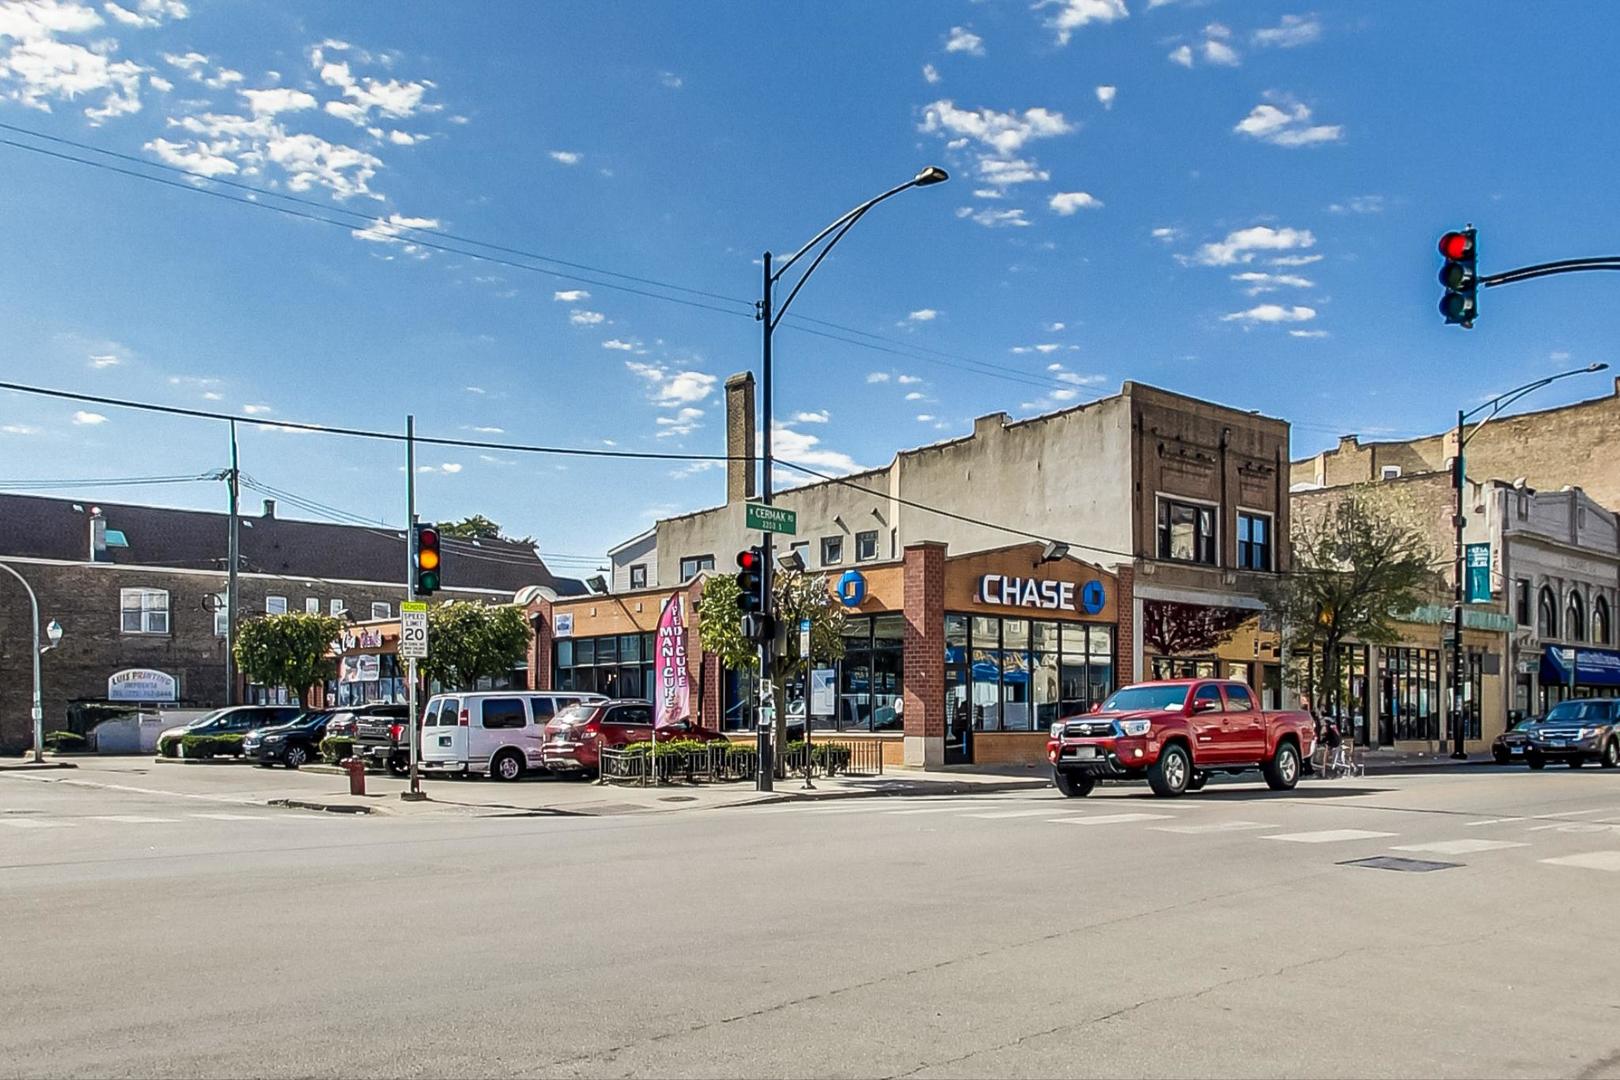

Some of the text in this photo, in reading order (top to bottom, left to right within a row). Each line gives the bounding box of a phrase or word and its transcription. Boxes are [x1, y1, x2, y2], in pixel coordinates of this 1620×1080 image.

[755, 508, 785, 522] CERMAK
[981, 574, 1076, 611] CHASE
[405, 628, 424, 641] 20
[672, 605, 688, 687] PEDICURE
[112, 671, 171, 686] LUIS PRINTING
[660, 626, 676, 708] MANICURE
